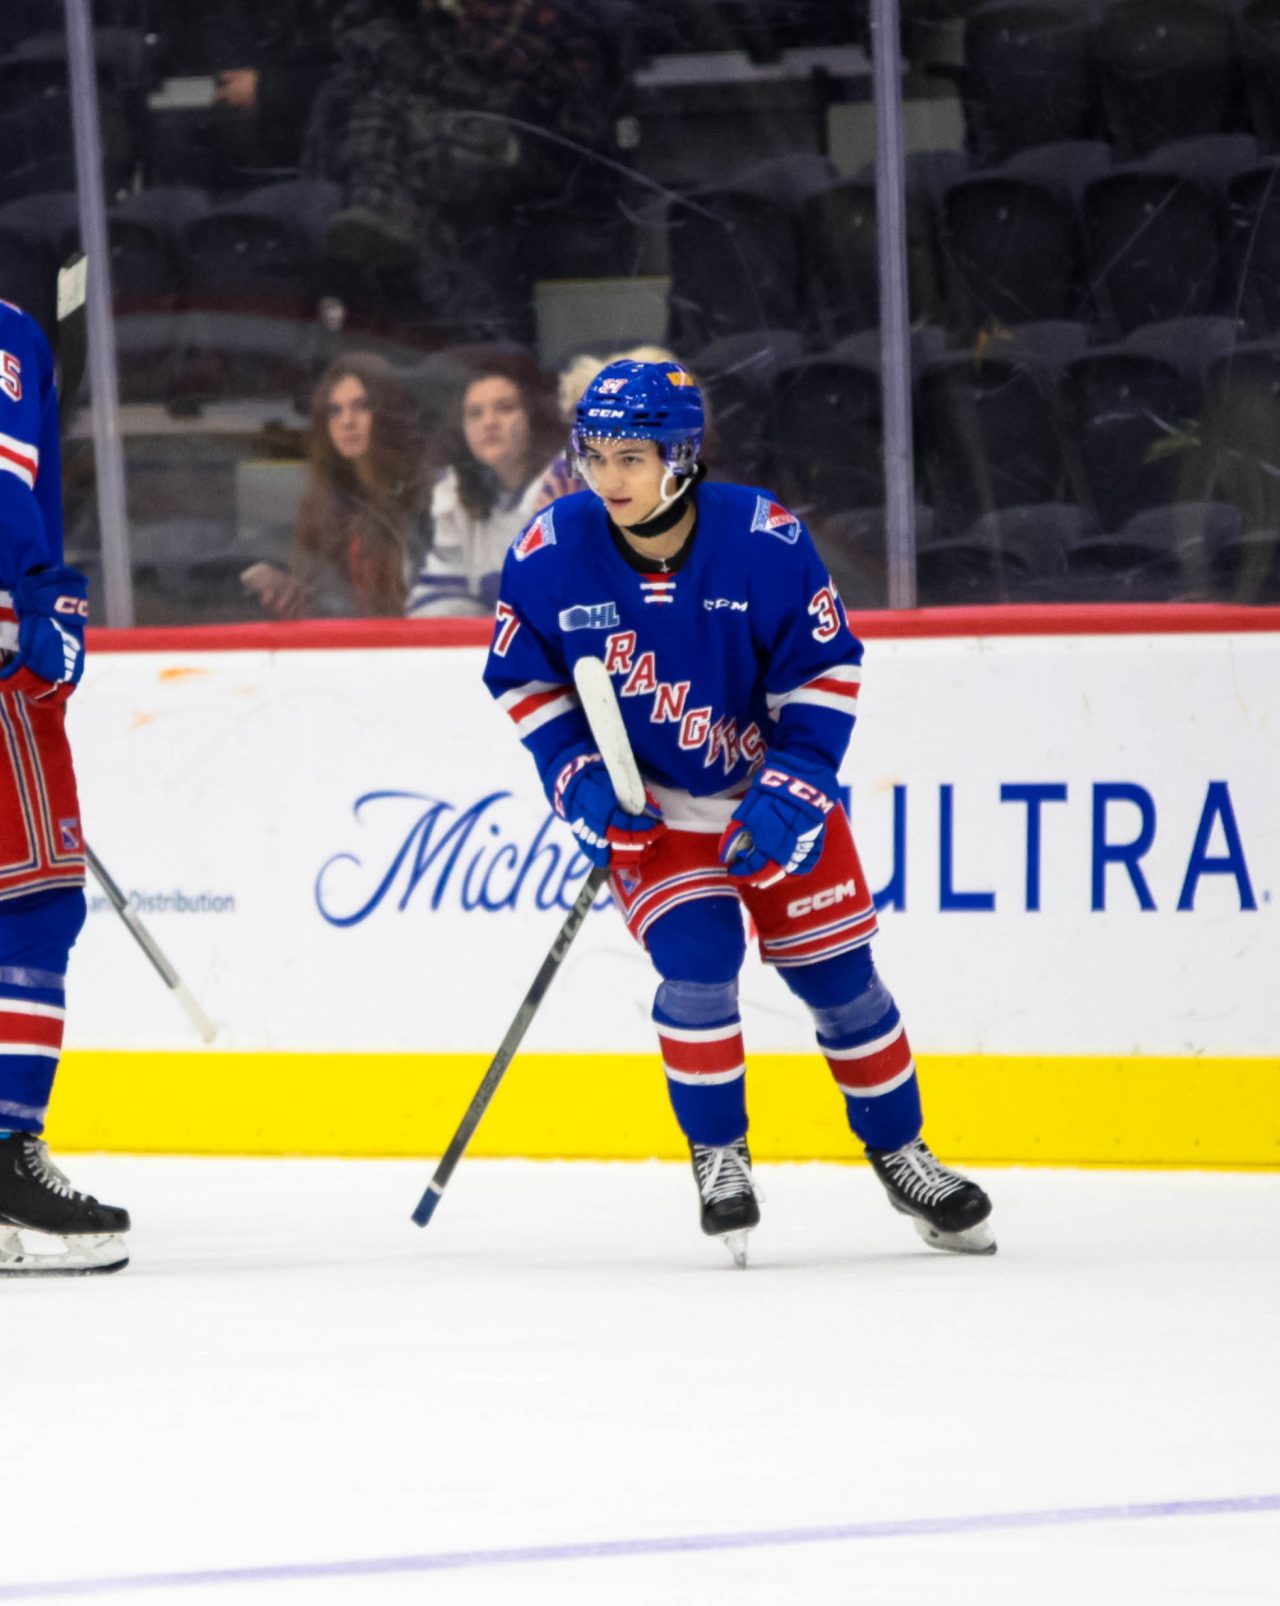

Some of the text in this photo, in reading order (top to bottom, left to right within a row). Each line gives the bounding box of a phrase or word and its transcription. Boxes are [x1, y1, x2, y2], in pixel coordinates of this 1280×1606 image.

[588, 408, 625, 418] CCM
[703, 599, 748, 611] CCM
[807, 573, 849, 644] 3
[493, 600, 521, 658] 7
[605, 629, 769, 777] RANGERS
[760, 768, 834, 814] CCM
[314, 781, 1258, 928] Miche ULTRA
[128, 888, 236, 915] Distribution
[786, 878, 856, 919] CCM
